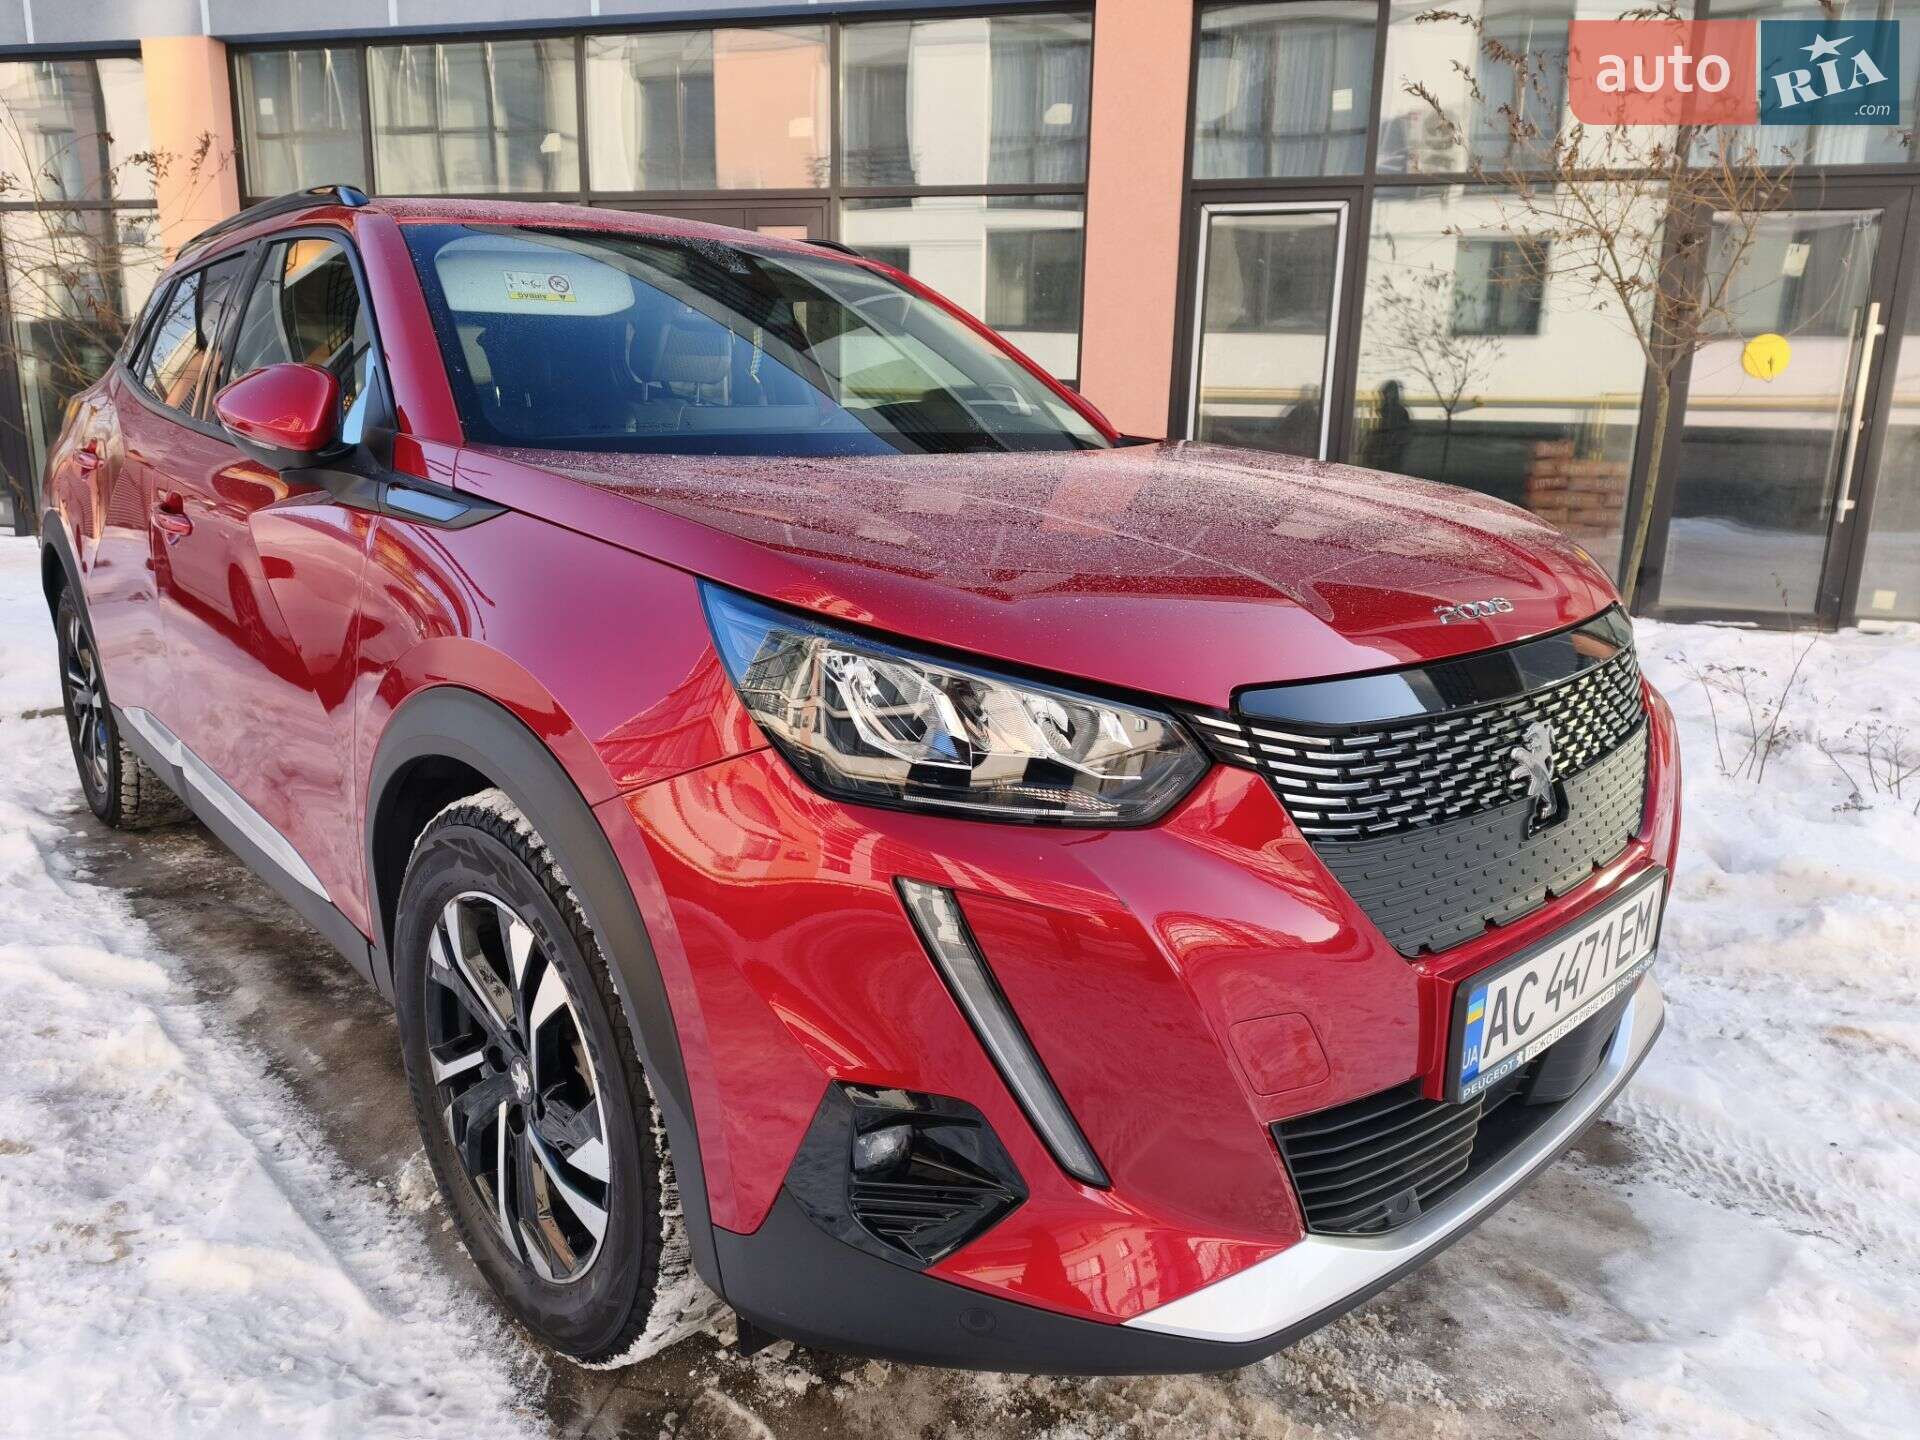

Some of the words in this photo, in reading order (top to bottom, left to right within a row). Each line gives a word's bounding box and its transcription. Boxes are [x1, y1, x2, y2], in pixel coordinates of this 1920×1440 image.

[1433, 597, 1514, 624] 2008
[1483, 971, 1538, 1058] AC
[1545, 921, 1614, 1012] 4471
[1615, 891, 1655, 969] EM
[1463, 1045, 1478, 1070] UA
[1463, 1058, 1514, 1099] PEUGEOT
